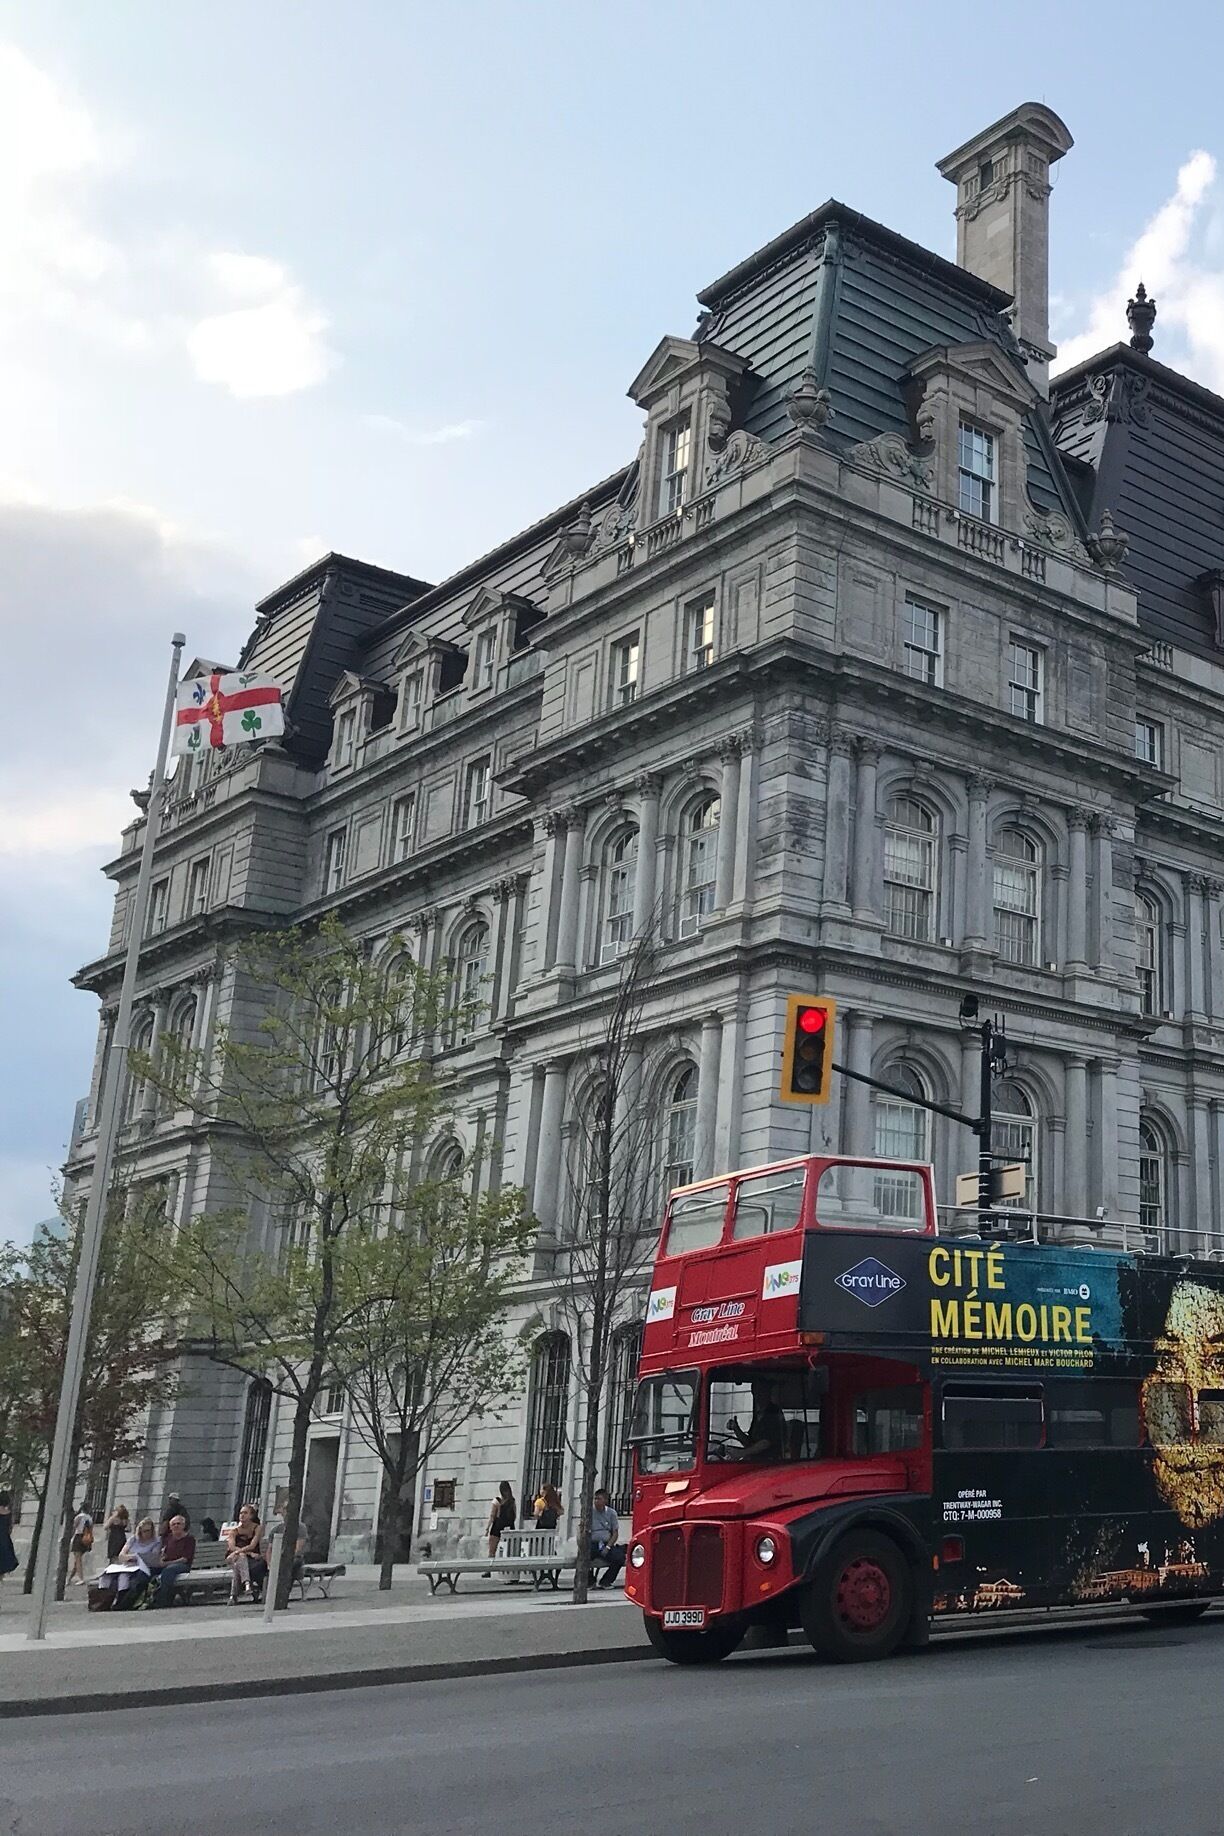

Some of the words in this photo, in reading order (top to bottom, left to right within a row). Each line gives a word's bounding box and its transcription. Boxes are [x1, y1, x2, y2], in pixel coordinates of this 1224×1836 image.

[928, 1240, 1006, 1290] CITÉ
[841, 1274, 875, 1288] Gray
[875, 1274, 901, 1289] Line
[690, 1305, 719, 1324] Gray
[718, 1301, 746, 1318] Line
[930, 1288, 1093, 1344] MÉMOIRE
[687, 1324, 739, 1348] Montréal
[943, 1346, 972, 1355] CRÉATION
[972, 1347, 980, 1355] DE
[981, 1346, 1008, 1356] MICHEL
[1009, 1347, 1040, 1357] LEMIEUX
[1040, 1349, 1048, 1357] ET
[1048, 1348, 1073, 1358] VICTOR
[1074, 1349, 1094, 1358] PILON
[931, 1356, 940, 1364] EN
[940, 1357, 988, 1365] COLLABORATION
[988, 1358, 1004, 1366] AVEC
[1004, 1357, 1033, 1366] MICHEL
[1033, 1358, 1055, 1367] MARC
[1055, 1359, 1094, 1368] BOUCHARD
[957, 1489, 975, 1499] OPÉRÉ
[975, 1490, 987, 1498] PAR
[943, 1500, 992, 1510] TRENTWAY-WAGAR
[992, 1499, 1003, 1508] INC.
[943, 1510, 960, 1521] CTQ:
[960, 1509, 1002, 1520] 7-M-000958
[665, 1611, 680, 1624] JJD
[681, 1611, 703, 1623] 399D
